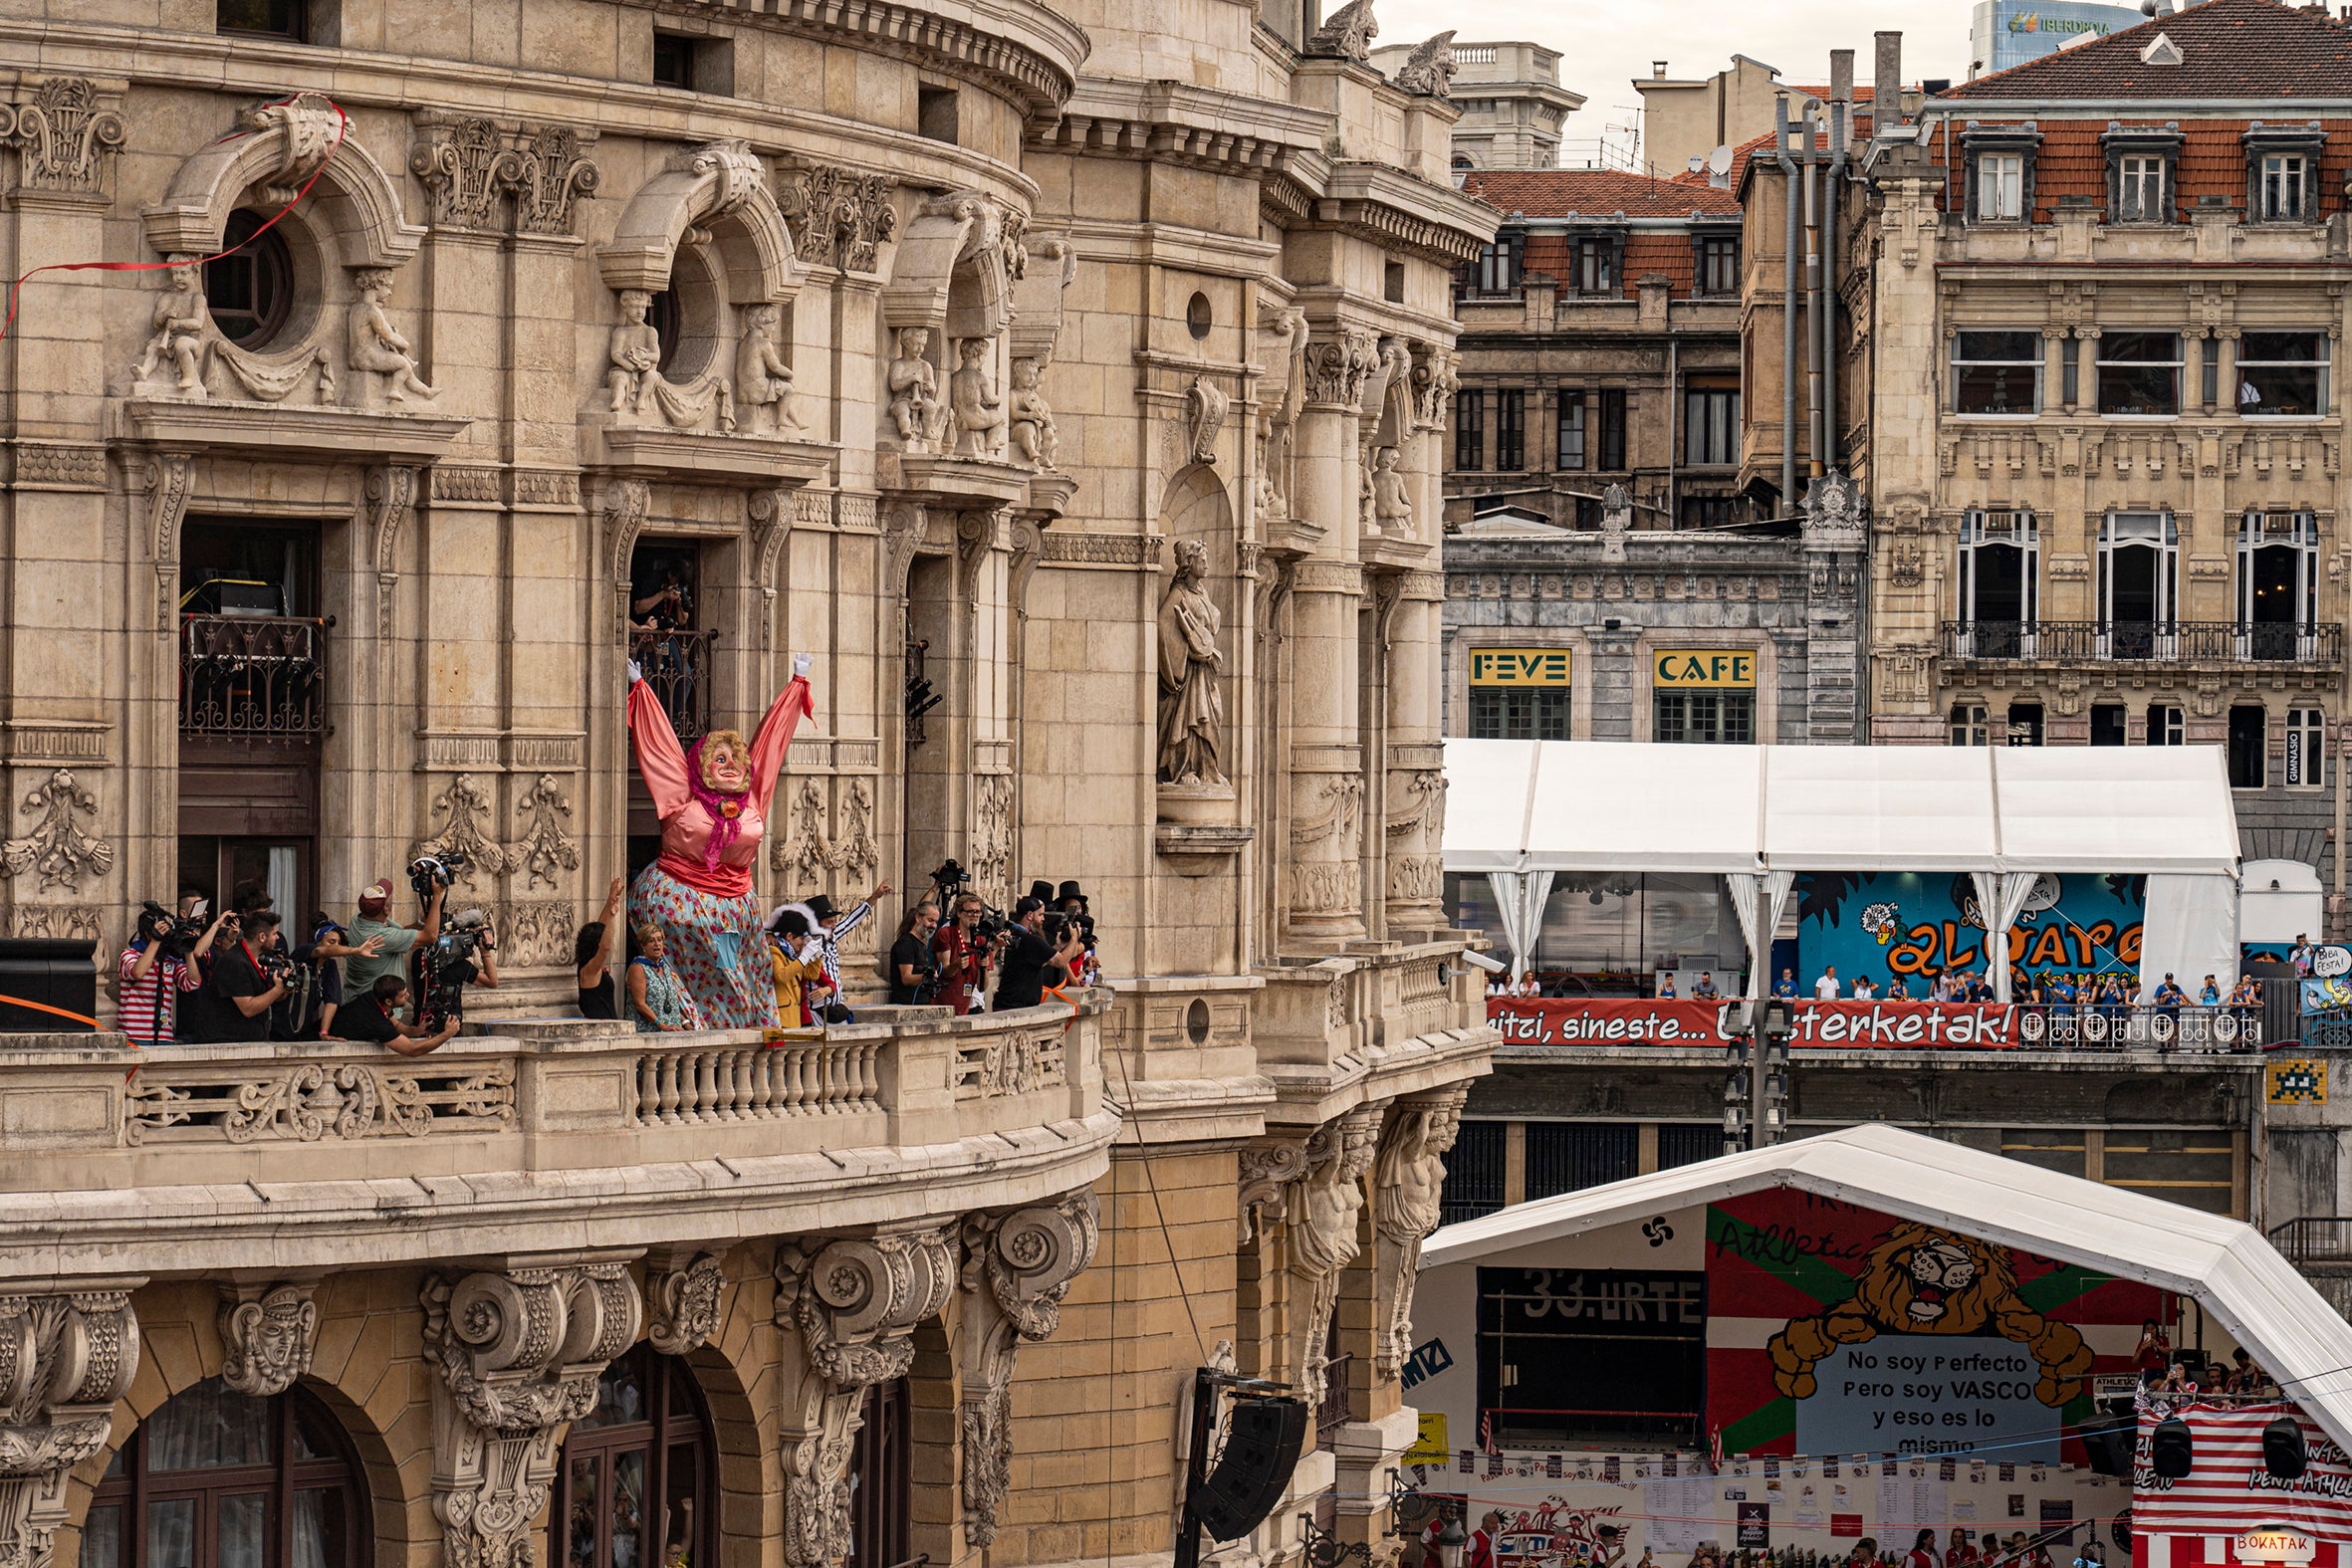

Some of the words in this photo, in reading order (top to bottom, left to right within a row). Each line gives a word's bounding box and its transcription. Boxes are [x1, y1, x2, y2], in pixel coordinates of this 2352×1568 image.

[2042, 18, 2111, 35] IBERDROLA
[1474, 654, 1566, 680] FEVE
[1658, 655, 1751, 681] CAFE
[2289, 733, 2298, 782] GIMNASIO
[2317, 958, 2344, 972] FESTA!
[1561, 1009, 1707, 1041] sineste...
[1848, 1351, 1878, 1369] No
[1887, 1355, 1927, 1375] soy
[1934, 1353, 2027, 1373] Perfecto
[1844, 1381, 1894, 1397] Pero
[1903, 1383, 1943, 1403] soy
[1951, 1381, 2031, 1401] VASCO
[1873, 1411, 1885, 1430] y
[1893, 1410, 1935, 1426] eso
[1942, 1411, 1968, 1427] es
[1975, 1409, 1996, 1427] lo
[1899, 1436, 1975, 1454] mismo
[2237, 1535, 2308, 1550] BOKATAK
